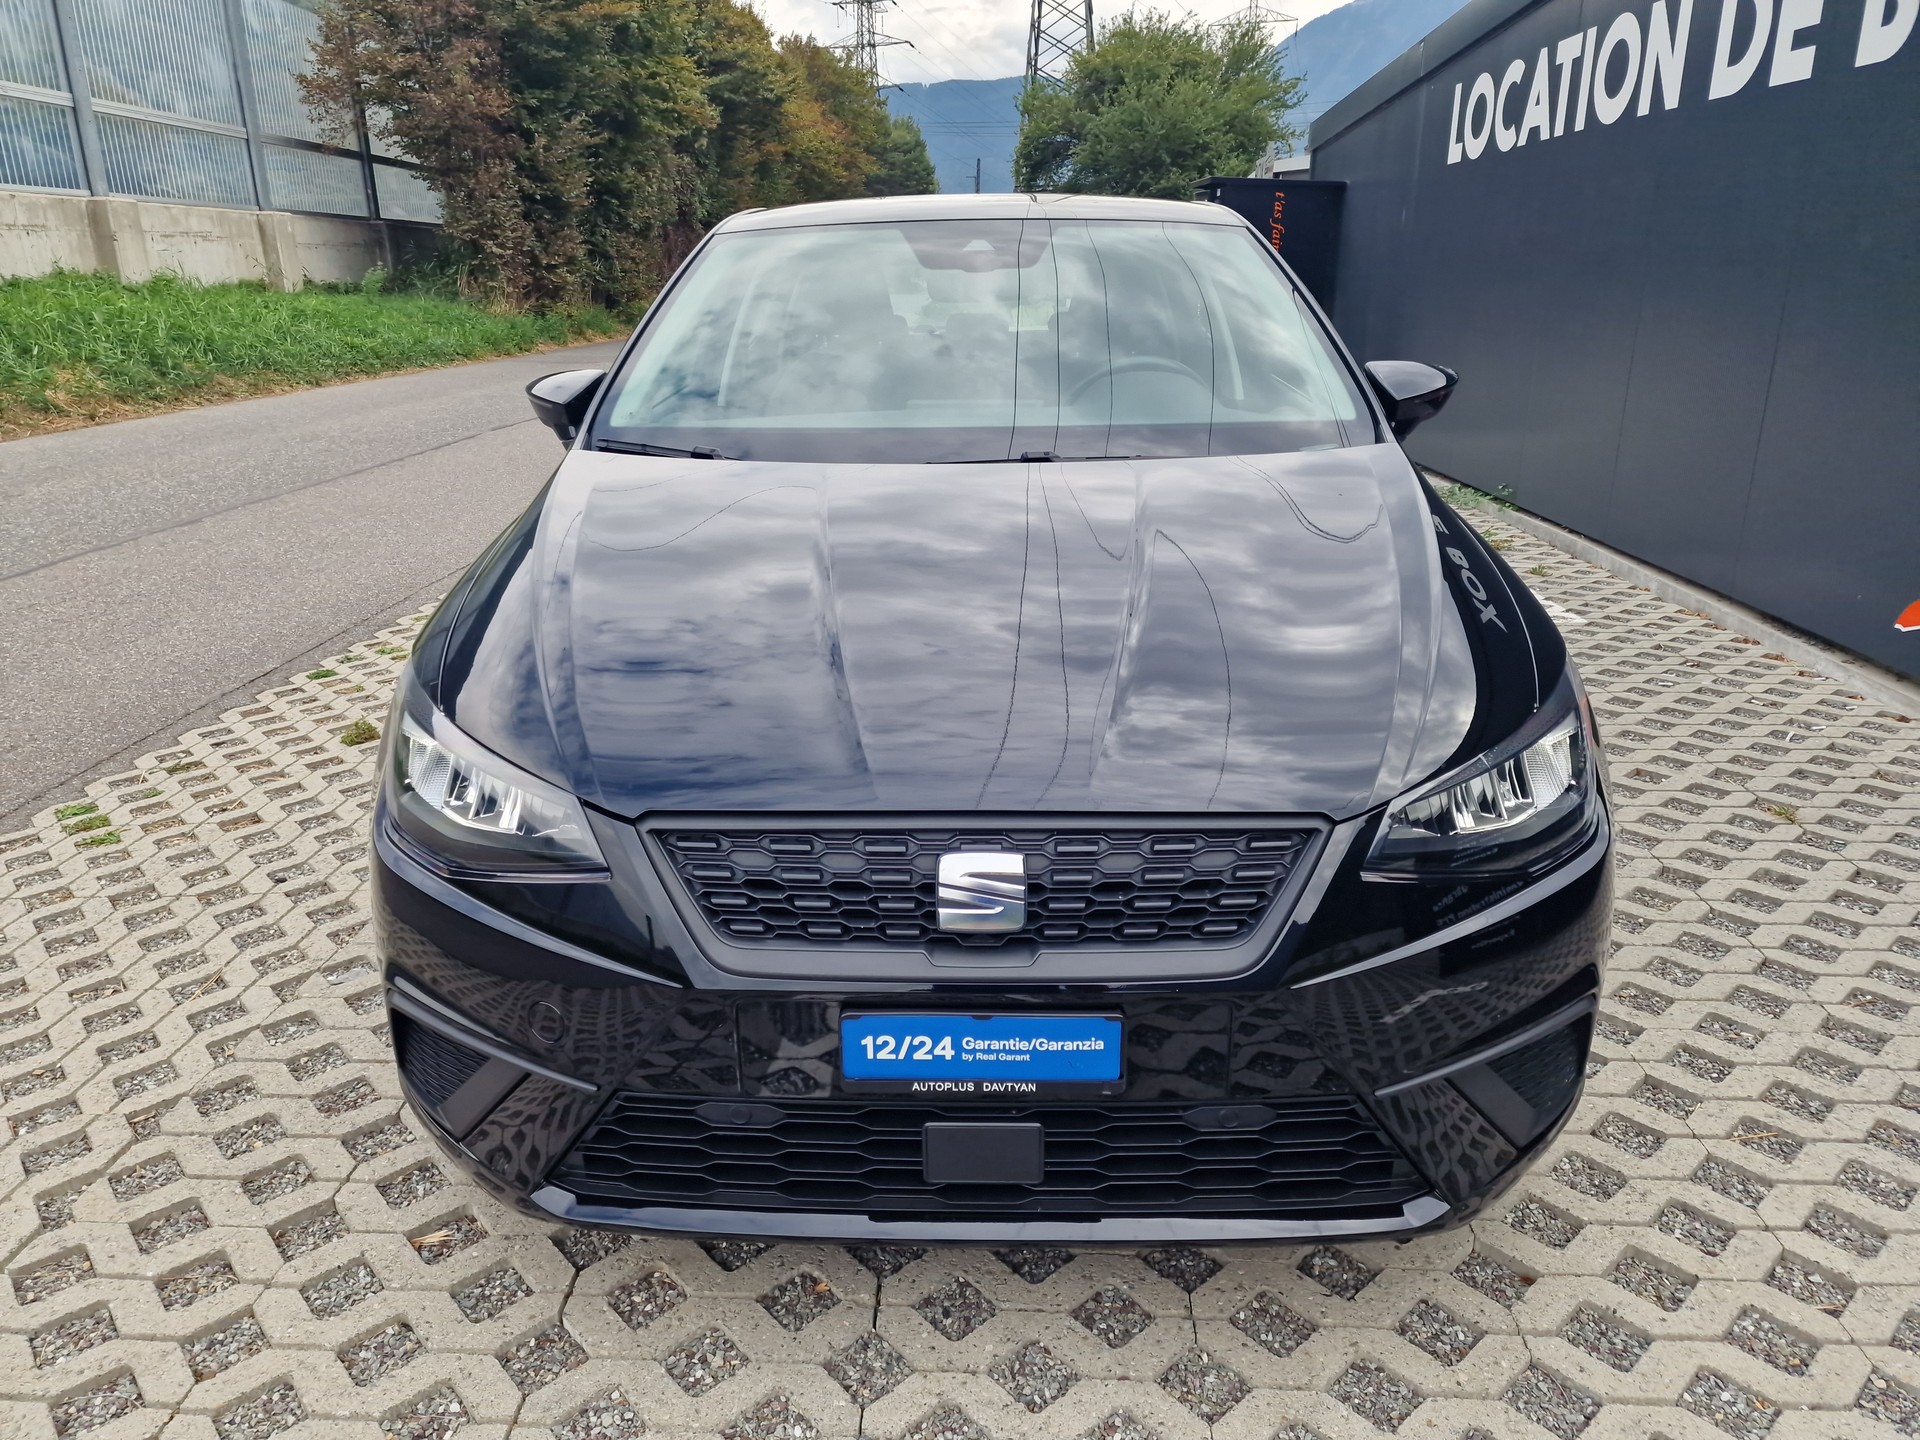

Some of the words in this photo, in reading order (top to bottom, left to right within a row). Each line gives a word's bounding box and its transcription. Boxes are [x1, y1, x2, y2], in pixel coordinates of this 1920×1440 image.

[1447, 0, 1694, 165] LOCATION
[1274, 191, 1286, 219] t'as
[860, 1035, 955, 1060] 12/24
[961, 1037, 1105, 1051] Garantie/Garanzia
[962, 1052, 973, 1062] by
[976, 1052, 997, 1061] Real
[998, 1052, 1030, 1062] Garant
[912, 1082, 975, 1092] AUTOPLUS
[983, 1082, 1036, 1092] DAVTYAN
